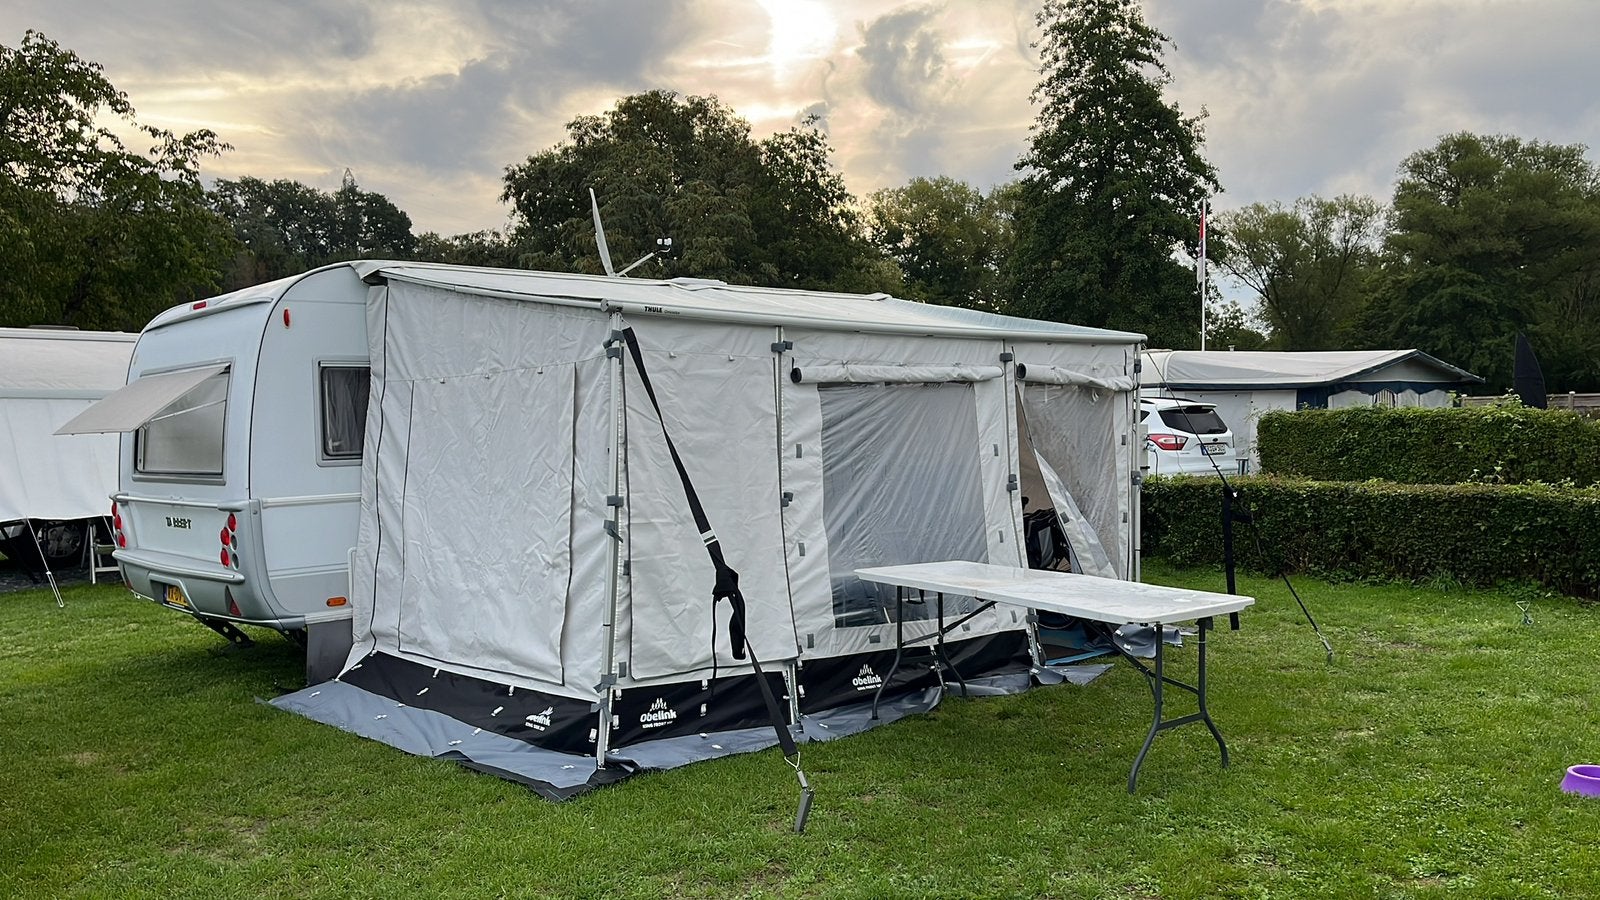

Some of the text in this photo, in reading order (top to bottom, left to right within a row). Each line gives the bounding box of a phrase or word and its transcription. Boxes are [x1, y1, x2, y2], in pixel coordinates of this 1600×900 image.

[644, 305, 662, 313] THULE
[852, 674, 882, 686] Obelink
[640, 709, 677, 722] Obelink
